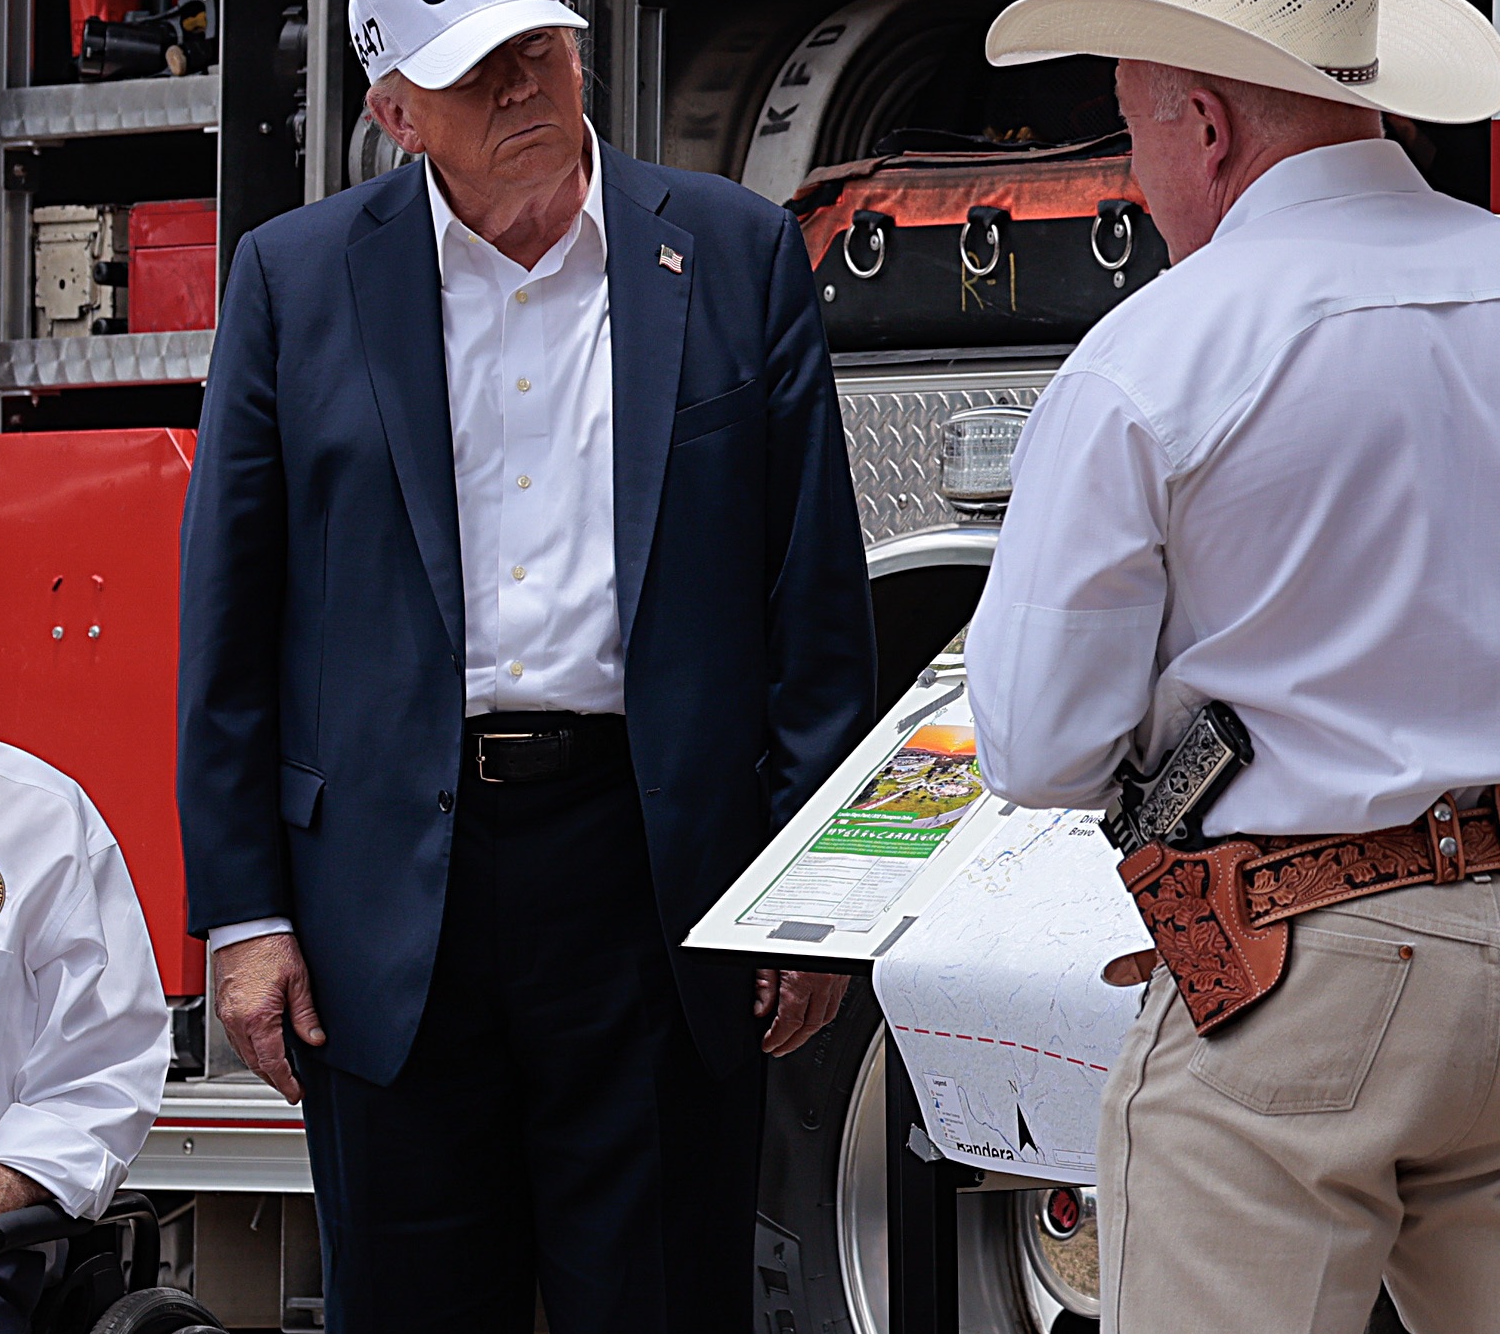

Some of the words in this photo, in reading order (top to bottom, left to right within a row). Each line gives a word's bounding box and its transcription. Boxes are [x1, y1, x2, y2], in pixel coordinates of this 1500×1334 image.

[759, 24, 847, 137] KFD
[961, 250, 1017, 312] R-1
[1080, 815, 1104, 825] Divis
[1068, 827, 1095, 837] Bravo
[1007, 1079, 1019, 1095] N
